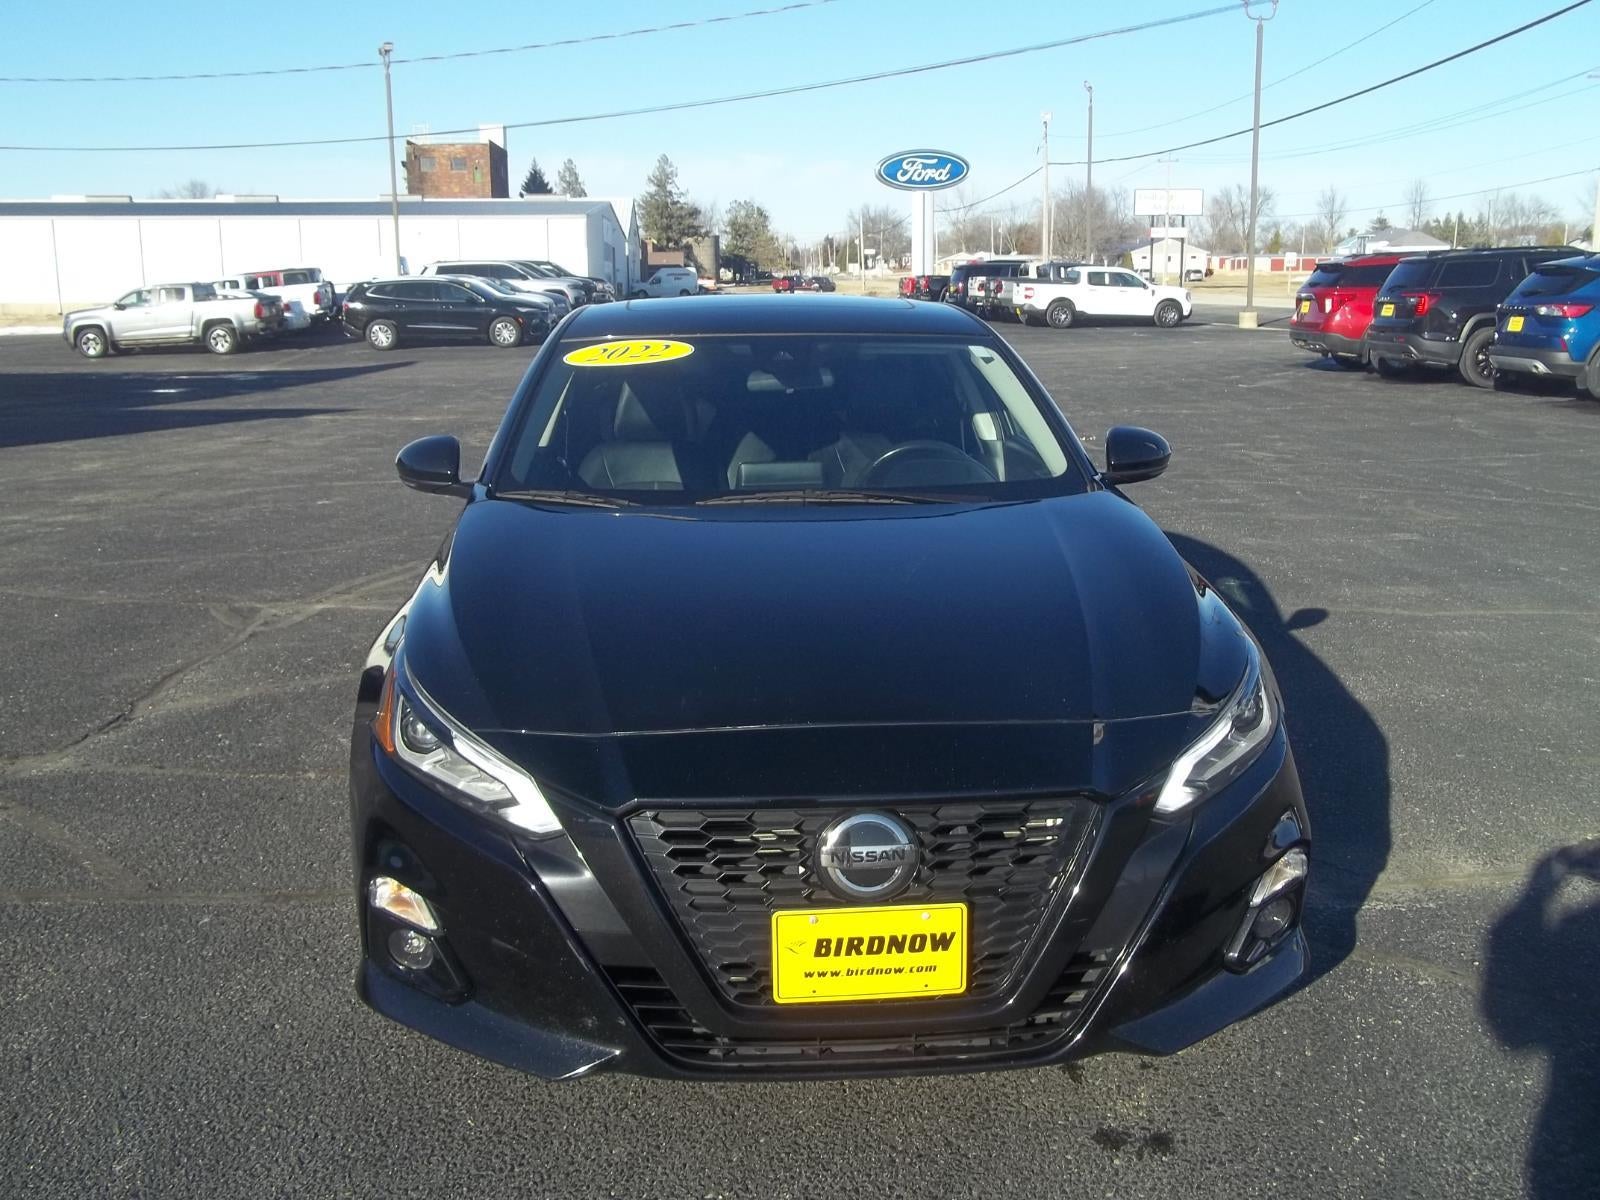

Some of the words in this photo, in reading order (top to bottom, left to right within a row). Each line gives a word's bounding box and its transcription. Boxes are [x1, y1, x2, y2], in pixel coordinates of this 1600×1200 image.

[896, 157, 952, 182] Ford
[586, 344, 672, 362] 2022
[830, 848, 906, 864] NISSAN
[813, 931, 956, 959] BIRDNOW
[803, 964, 937, 979] www.birdnow.com
